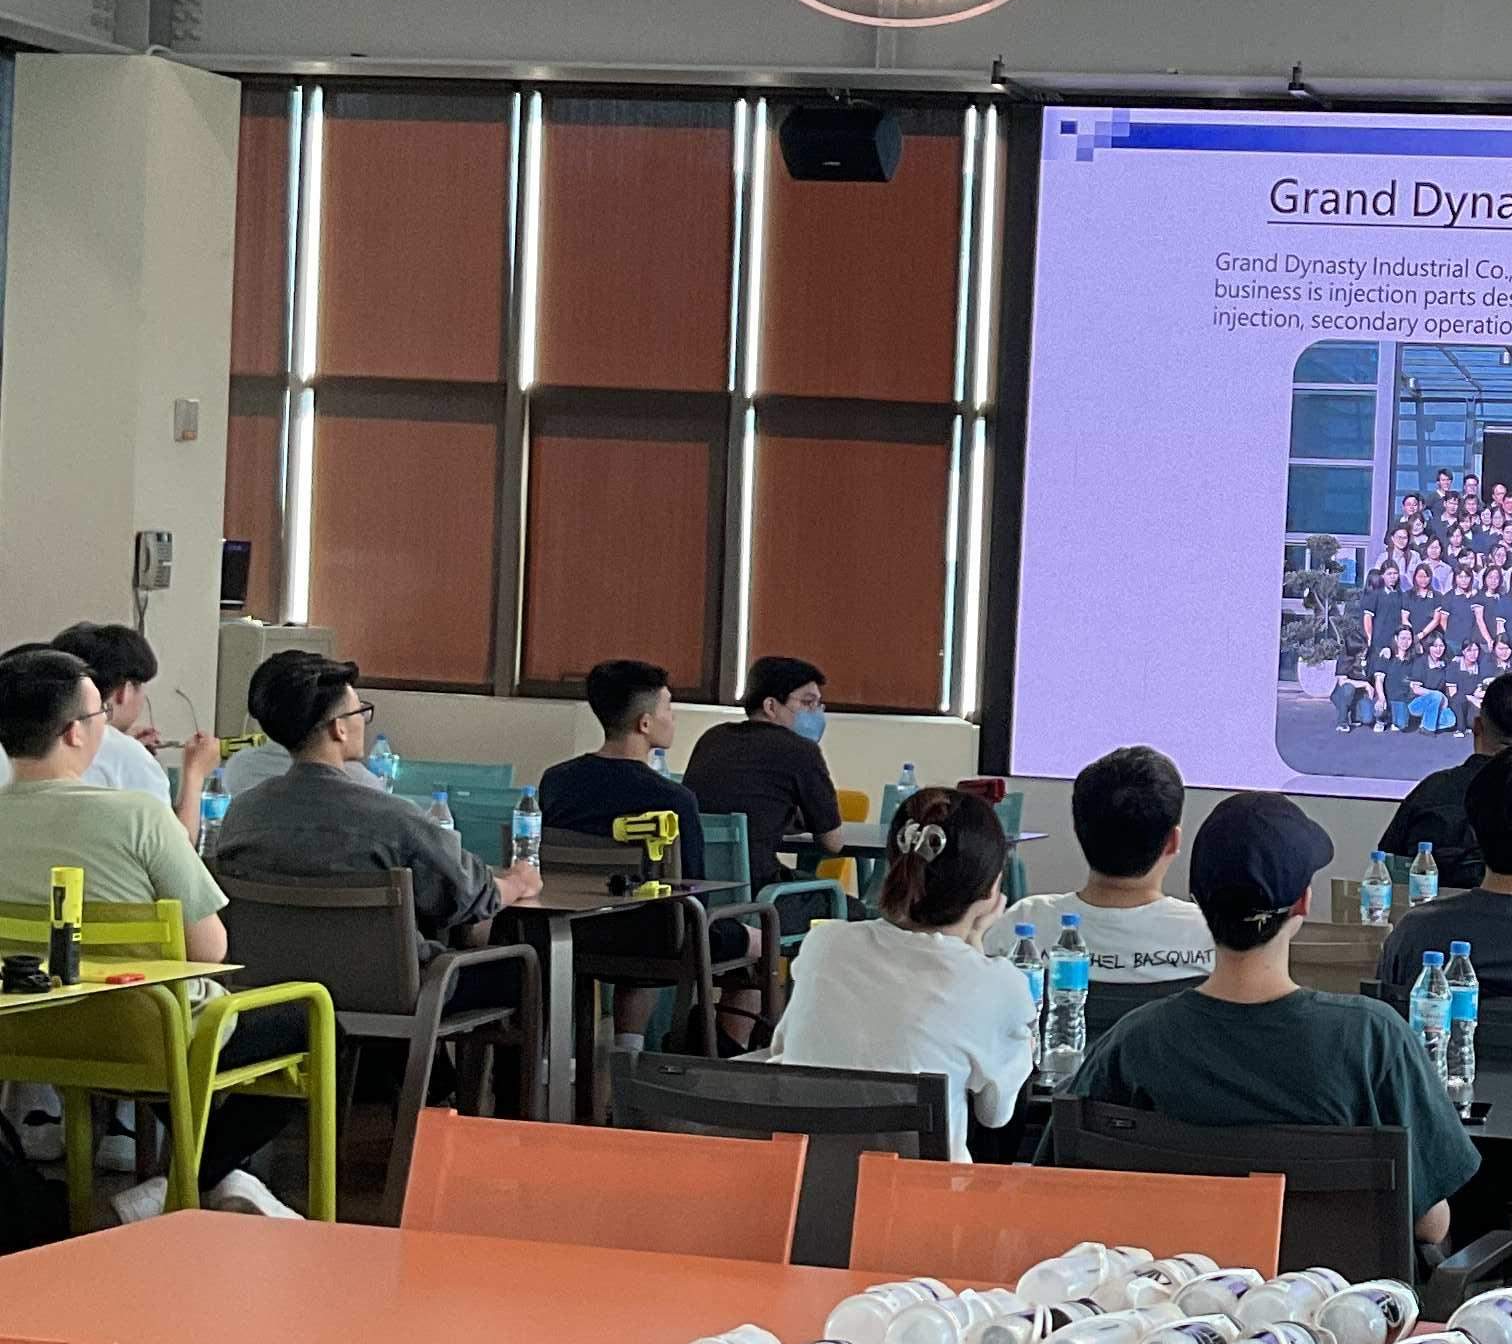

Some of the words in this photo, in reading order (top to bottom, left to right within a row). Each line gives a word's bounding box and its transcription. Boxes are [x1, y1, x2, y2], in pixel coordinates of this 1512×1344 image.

[1270, 178, 1397, 215] Grand
[1215, 252, 1277, 273] Grand
[1285, 255, 1367, 280] Dynasty
[1373, 257, 1468, 279] Industrial
[1215, 278, 1301, 300] business
[1308, 283, 1322, 300] is
[1330, 282, 1417, 305] injection
[1424, 288, 1476, 309] parts
[1213, 307, 1304, 332] injection,
[1312, 311, 1418, 337] secondary
[1133, 948, 1215, 969] BASQUIAT
